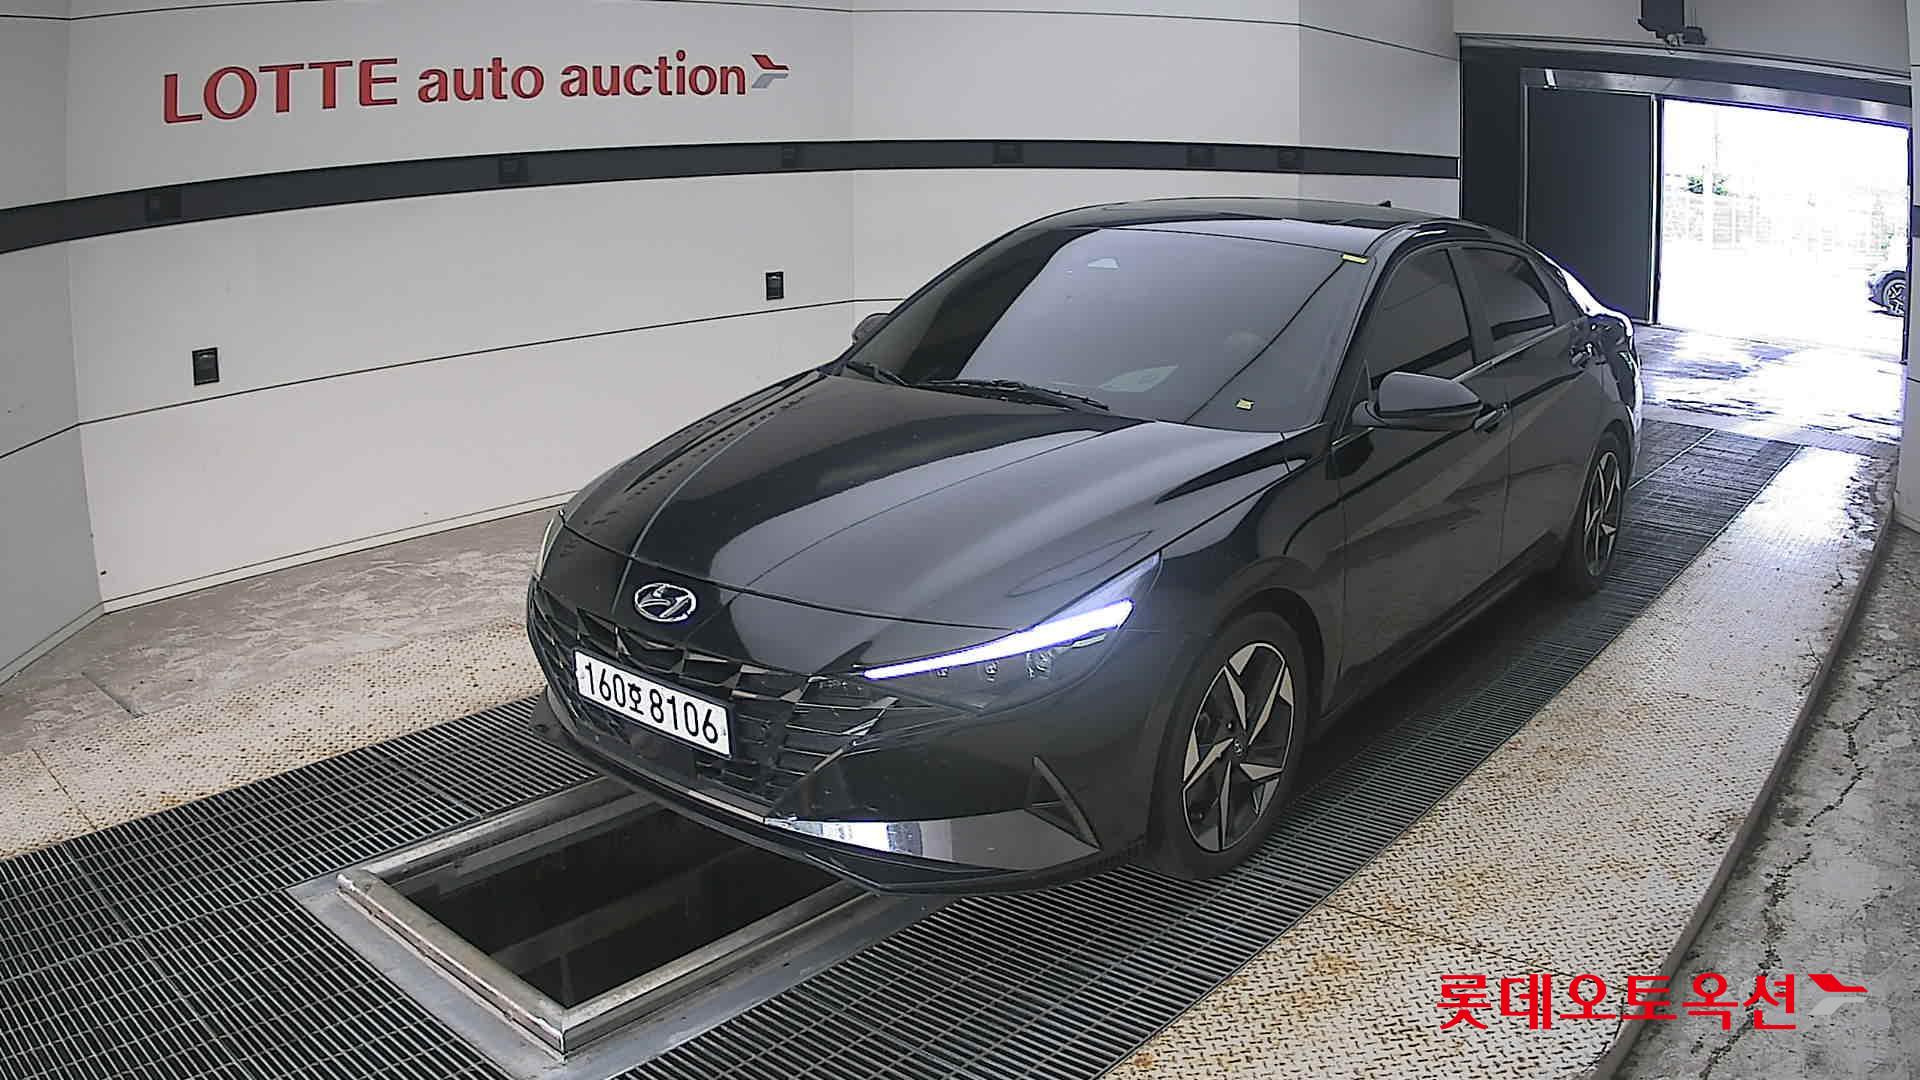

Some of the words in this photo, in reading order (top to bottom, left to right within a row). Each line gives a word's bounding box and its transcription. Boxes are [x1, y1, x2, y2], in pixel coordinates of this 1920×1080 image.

[163, 57, 399, 124] LOTTE
[417, 56, 545, 104] auto
[560, 49, 747, 98] auction
